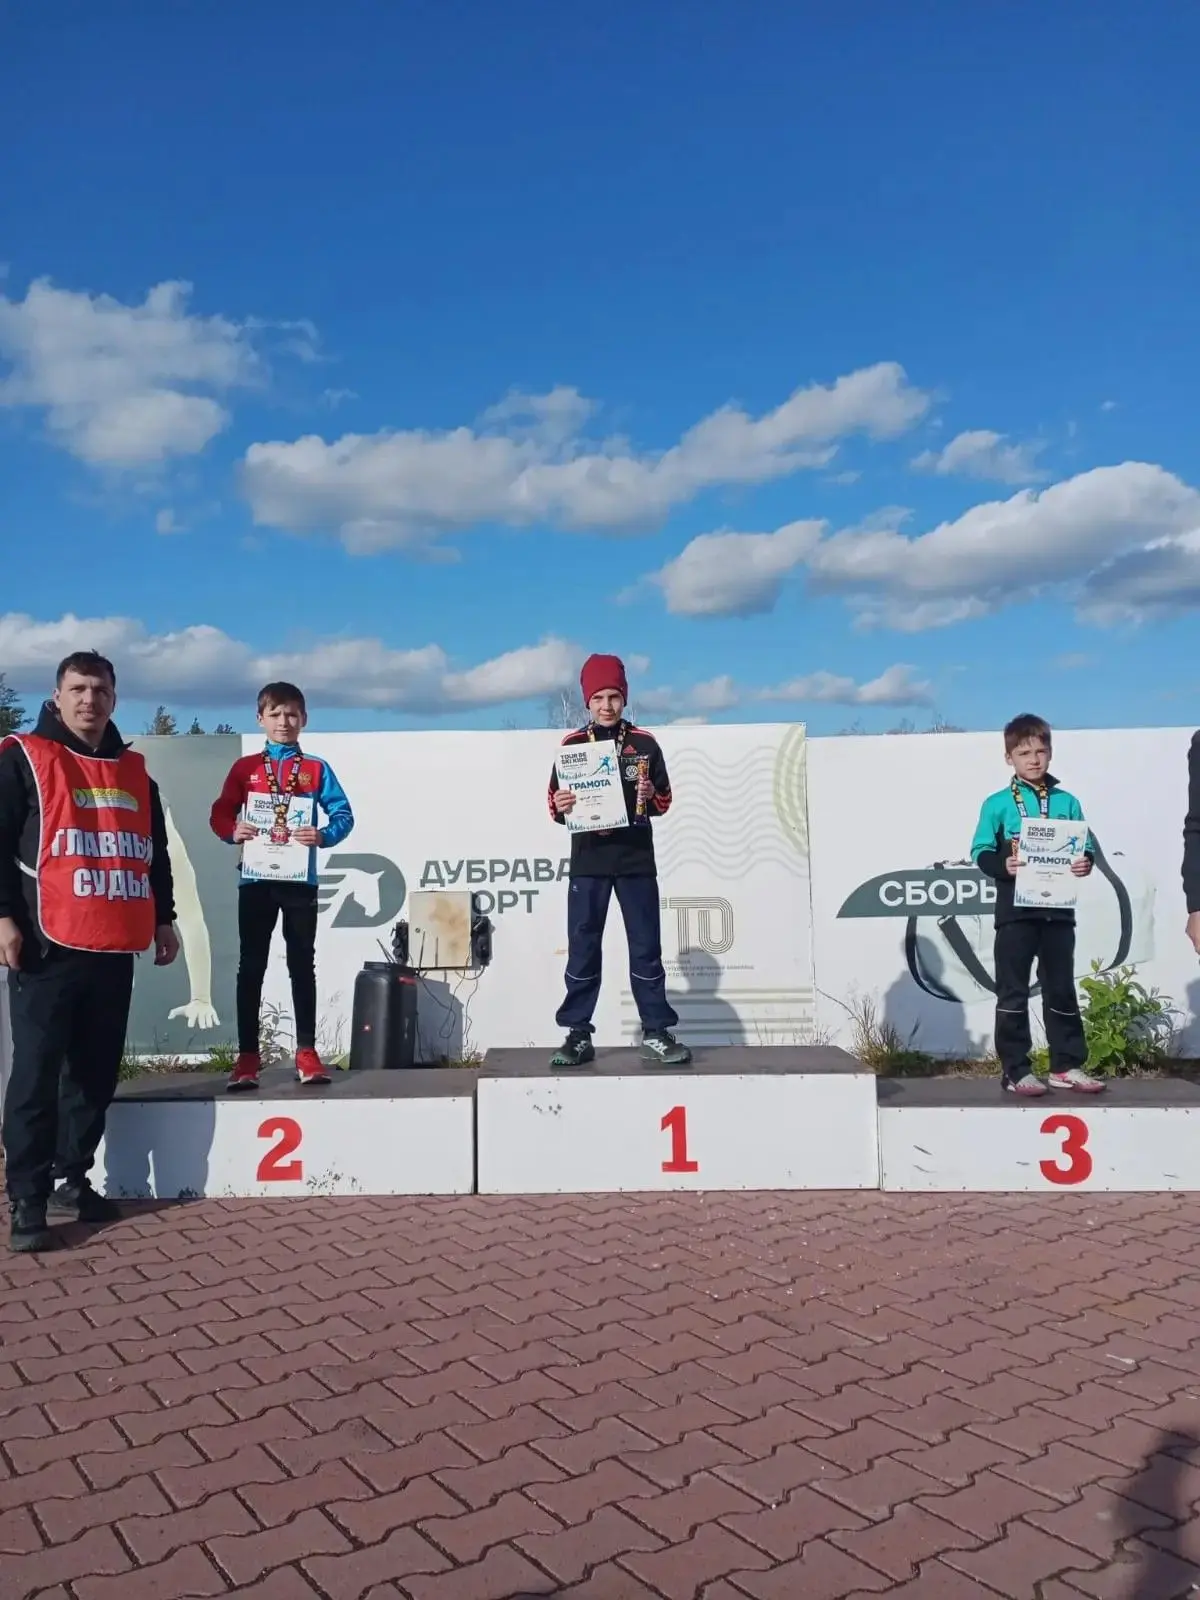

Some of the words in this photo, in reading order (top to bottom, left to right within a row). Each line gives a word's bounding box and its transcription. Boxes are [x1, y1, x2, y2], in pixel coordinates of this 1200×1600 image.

[569, 779, 612, 791] ГРАМОТА
[1027, 855, 1072, 865] ГРАМОТА
[472, 890, 539, 915] ОРТ
[257, 1117, 303, 1182] 2
[661, 1105, 699, 1173] 1
[1040, 1113, 1092, 1184] 3
